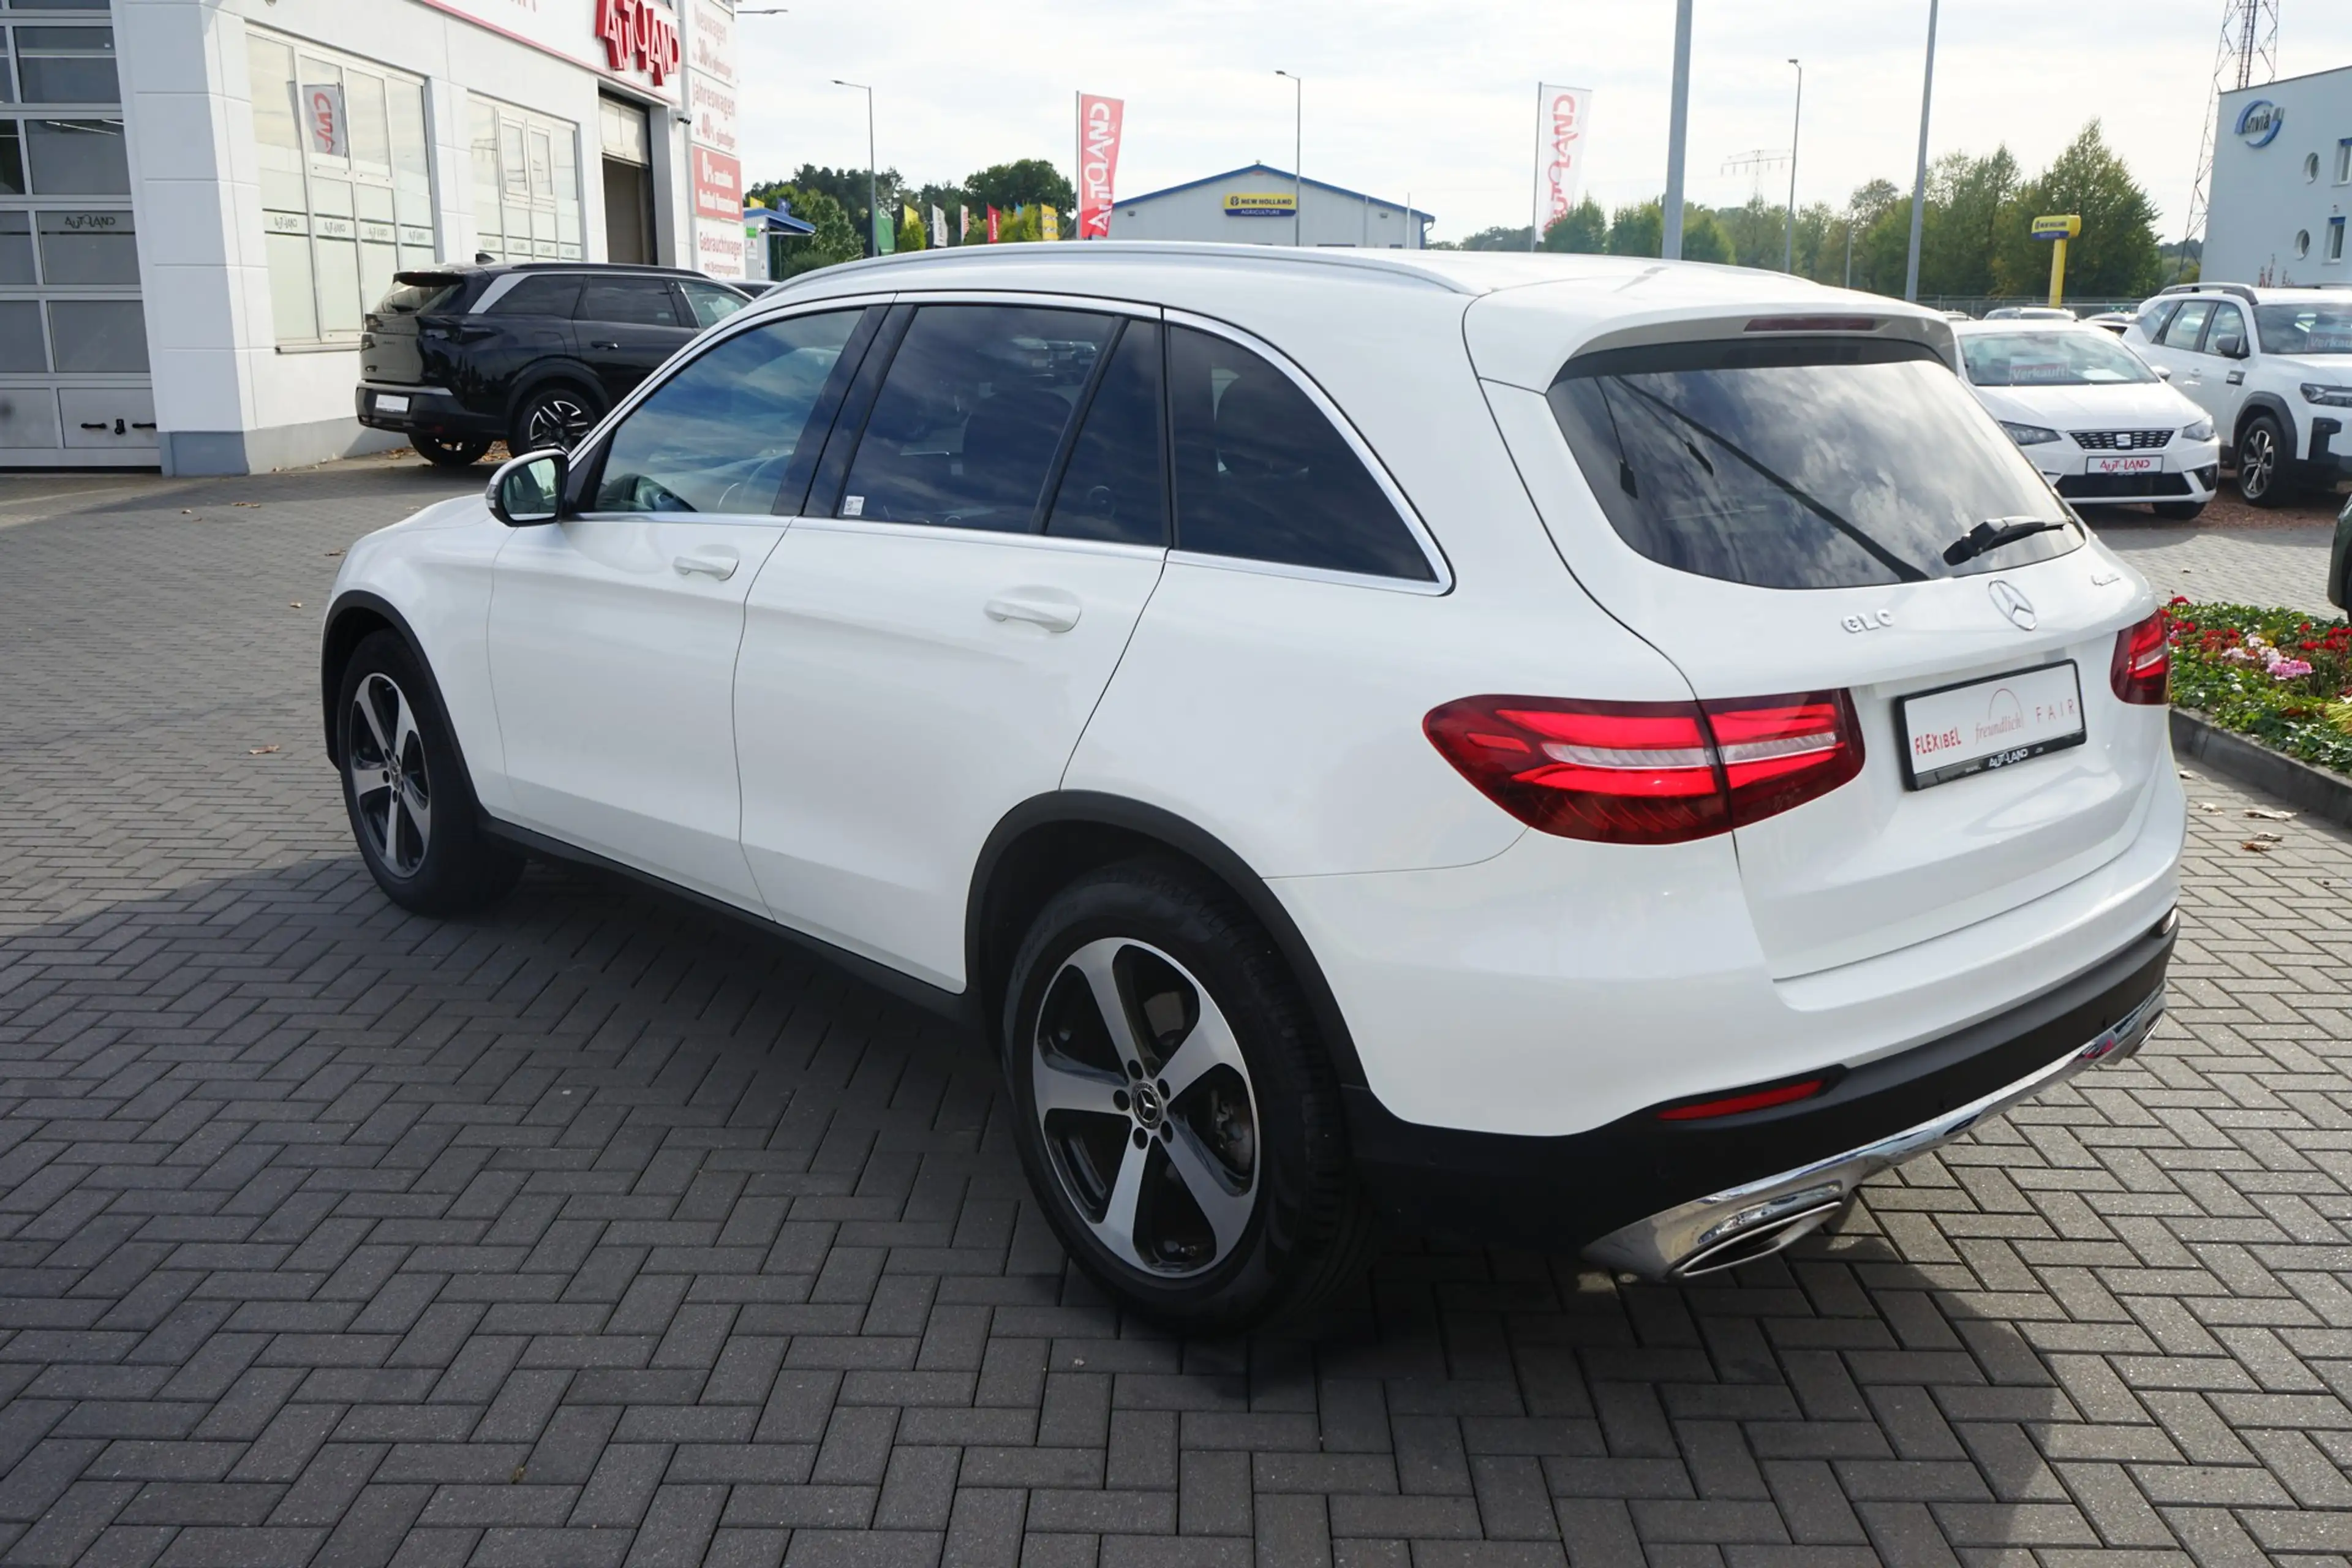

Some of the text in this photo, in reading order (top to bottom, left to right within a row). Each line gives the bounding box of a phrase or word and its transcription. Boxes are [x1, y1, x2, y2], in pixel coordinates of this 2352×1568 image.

[692, 76, 736, 121] Jahreswagen
[2013, 366, 2068, 380] Verkauft
[1841, 609, 1895, 634] GLC
[1915, 726, 1962, 755] FLEXIBEL
[1975, 712, 2024, 745] freundlich
